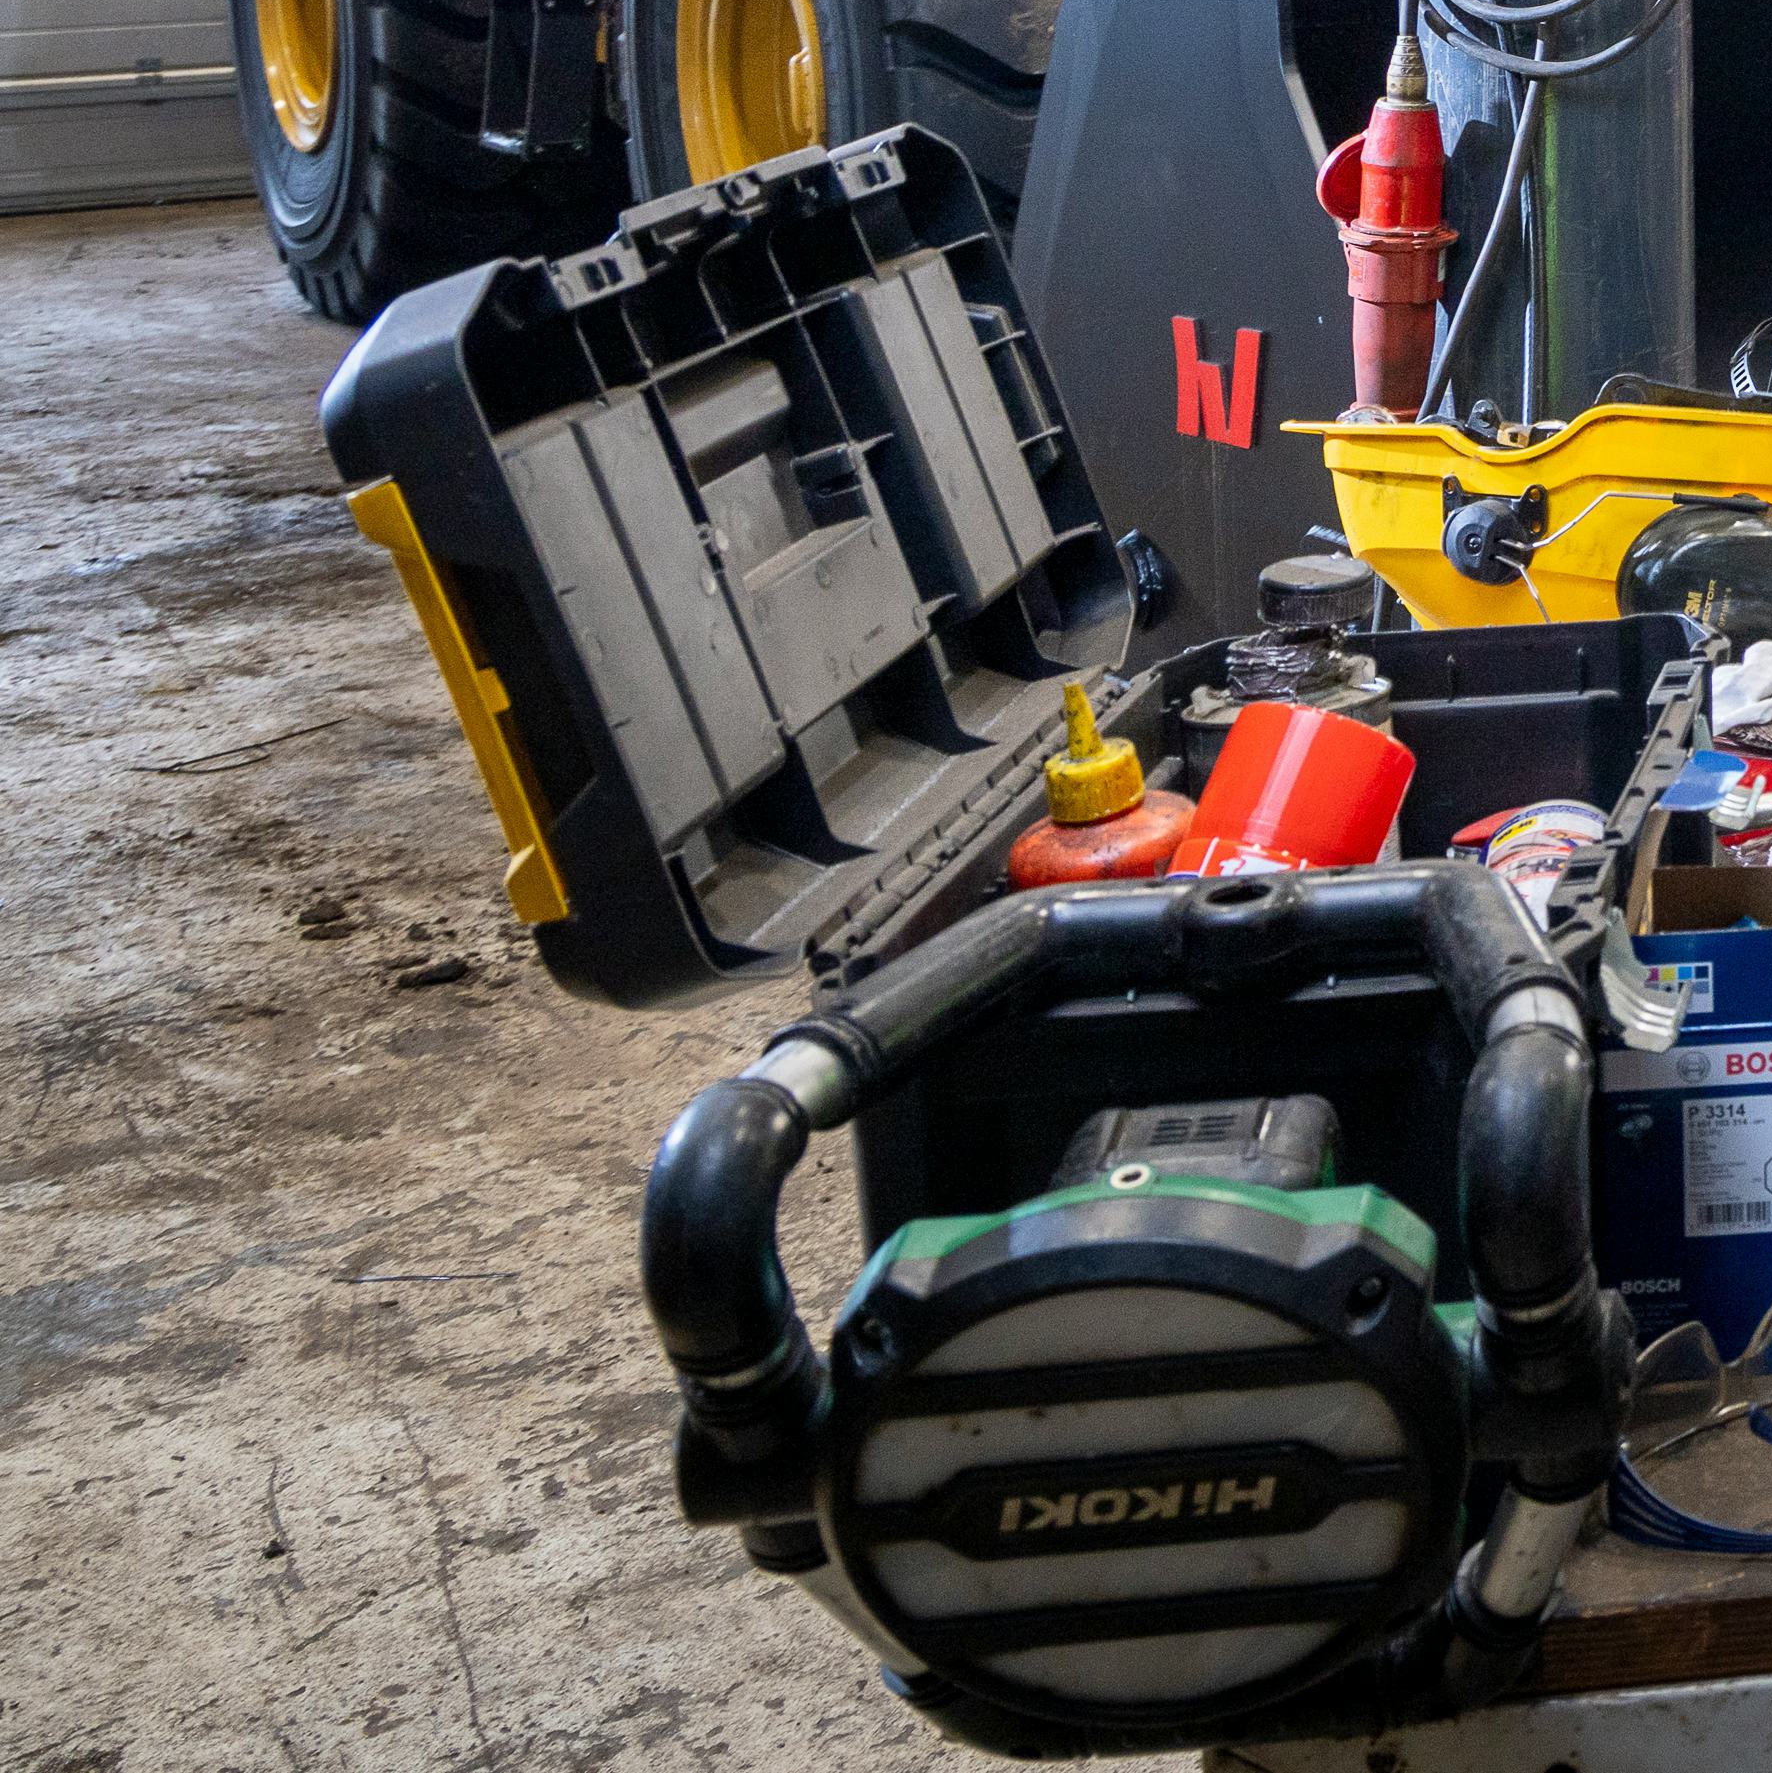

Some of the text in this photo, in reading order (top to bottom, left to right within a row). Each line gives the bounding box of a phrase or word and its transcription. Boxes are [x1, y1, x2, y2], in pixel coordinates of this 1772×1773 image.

[1684, 591, 1703, 618] 3M
[1688, 1103, 1746, 1121] P 3314
[1620, 1278, 1681, 1295] BOSCH
